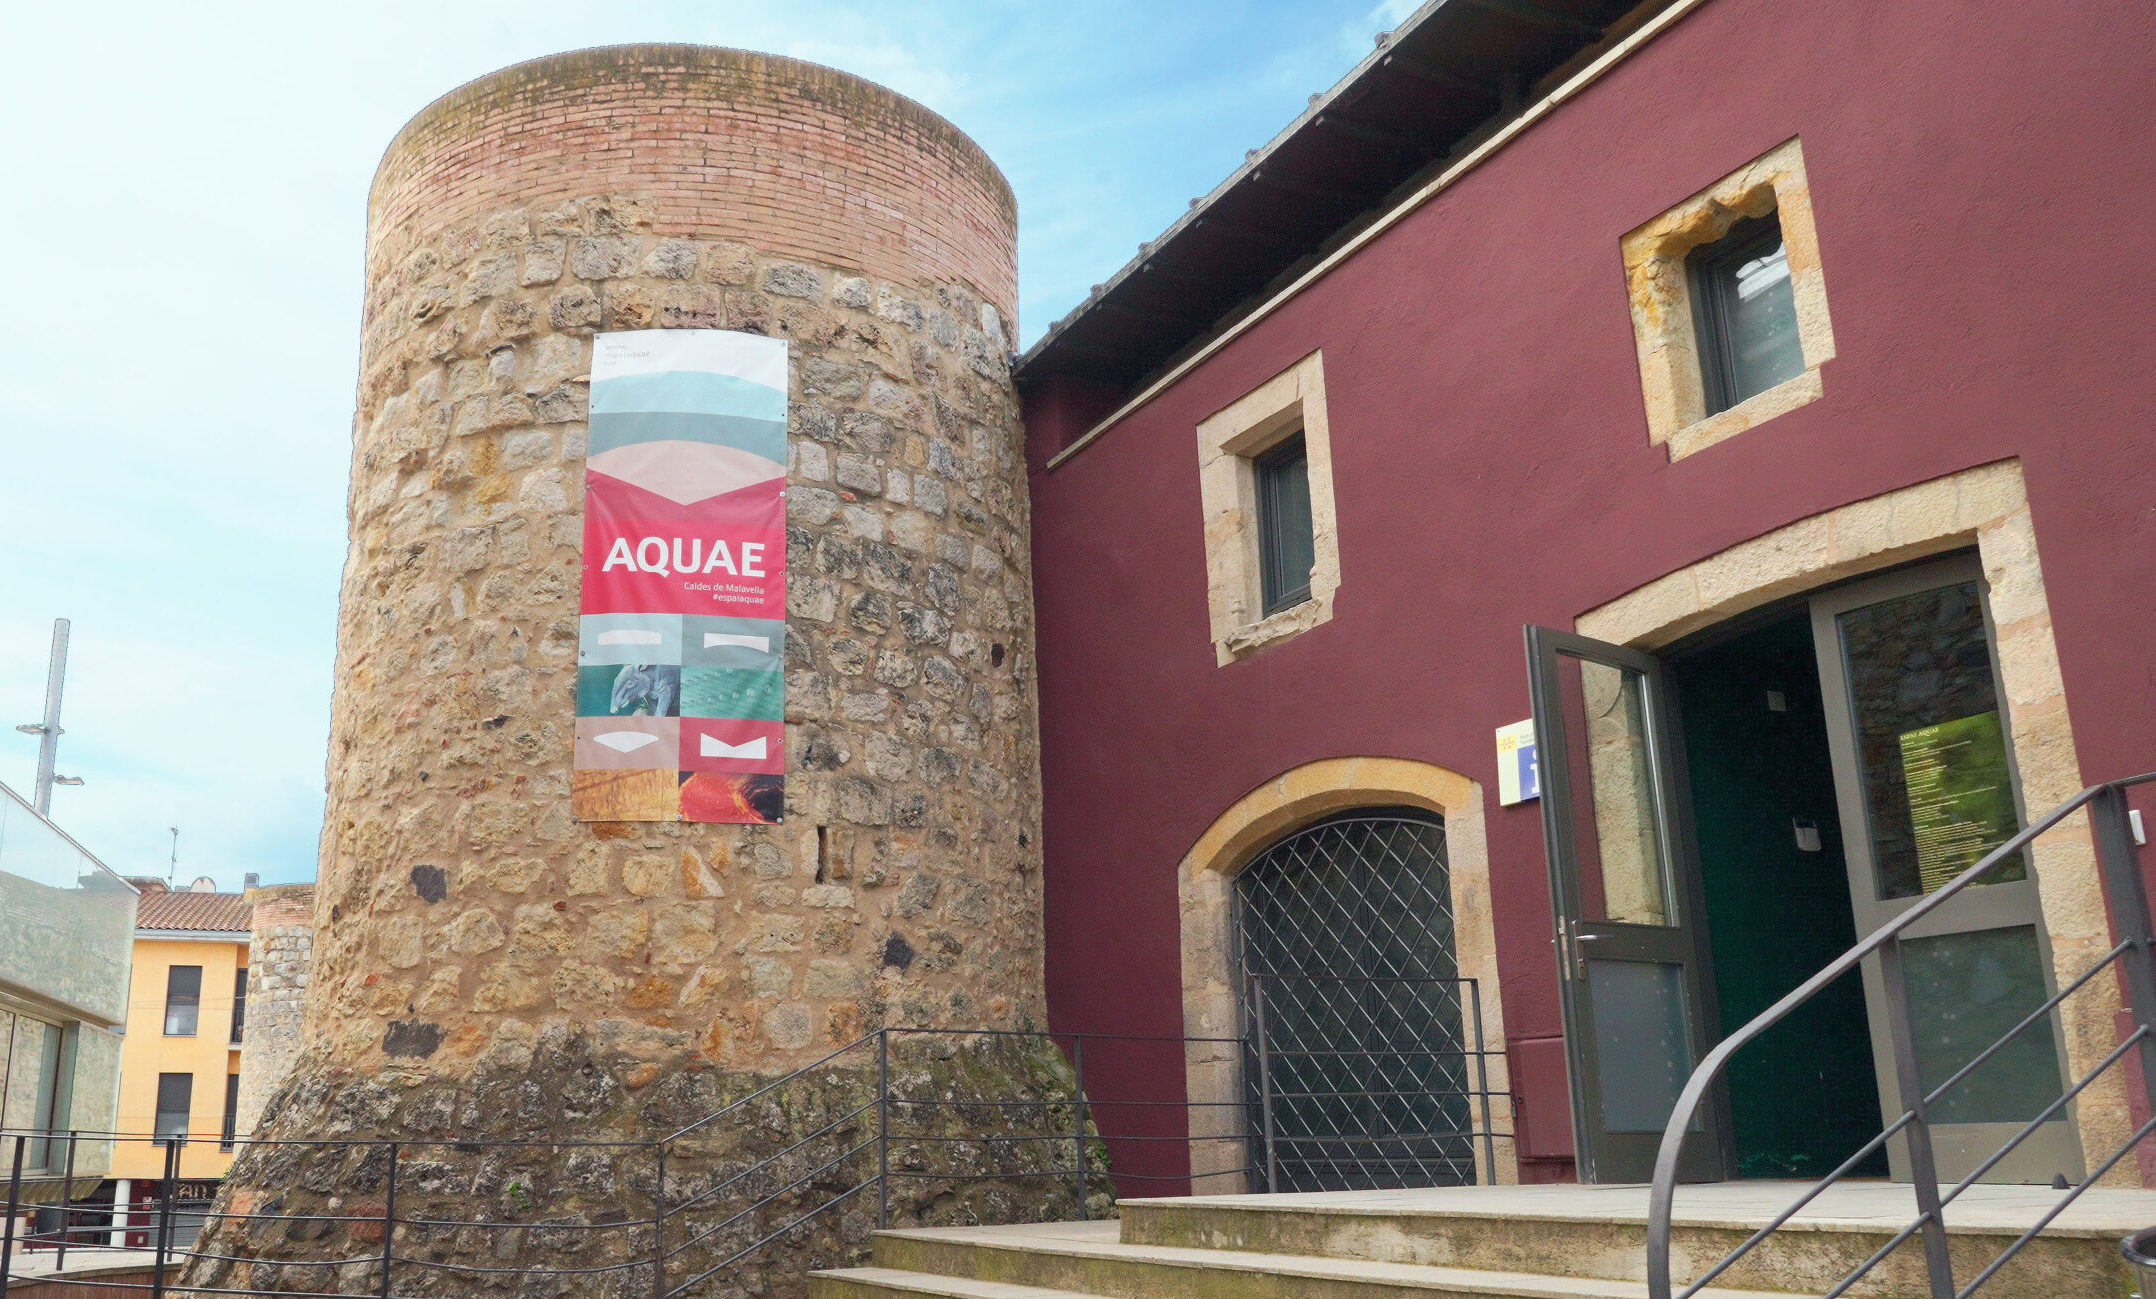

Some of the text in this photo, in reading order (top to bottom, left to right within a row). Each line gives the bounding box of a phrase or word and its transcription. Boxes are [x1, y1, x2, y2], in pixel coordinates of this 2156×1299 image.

[602, 536, 766, 578] AQUAE
[683, 581, 765, 594] Caldes de Malavella
[713, 594, 765, 604] #espaiaquae
